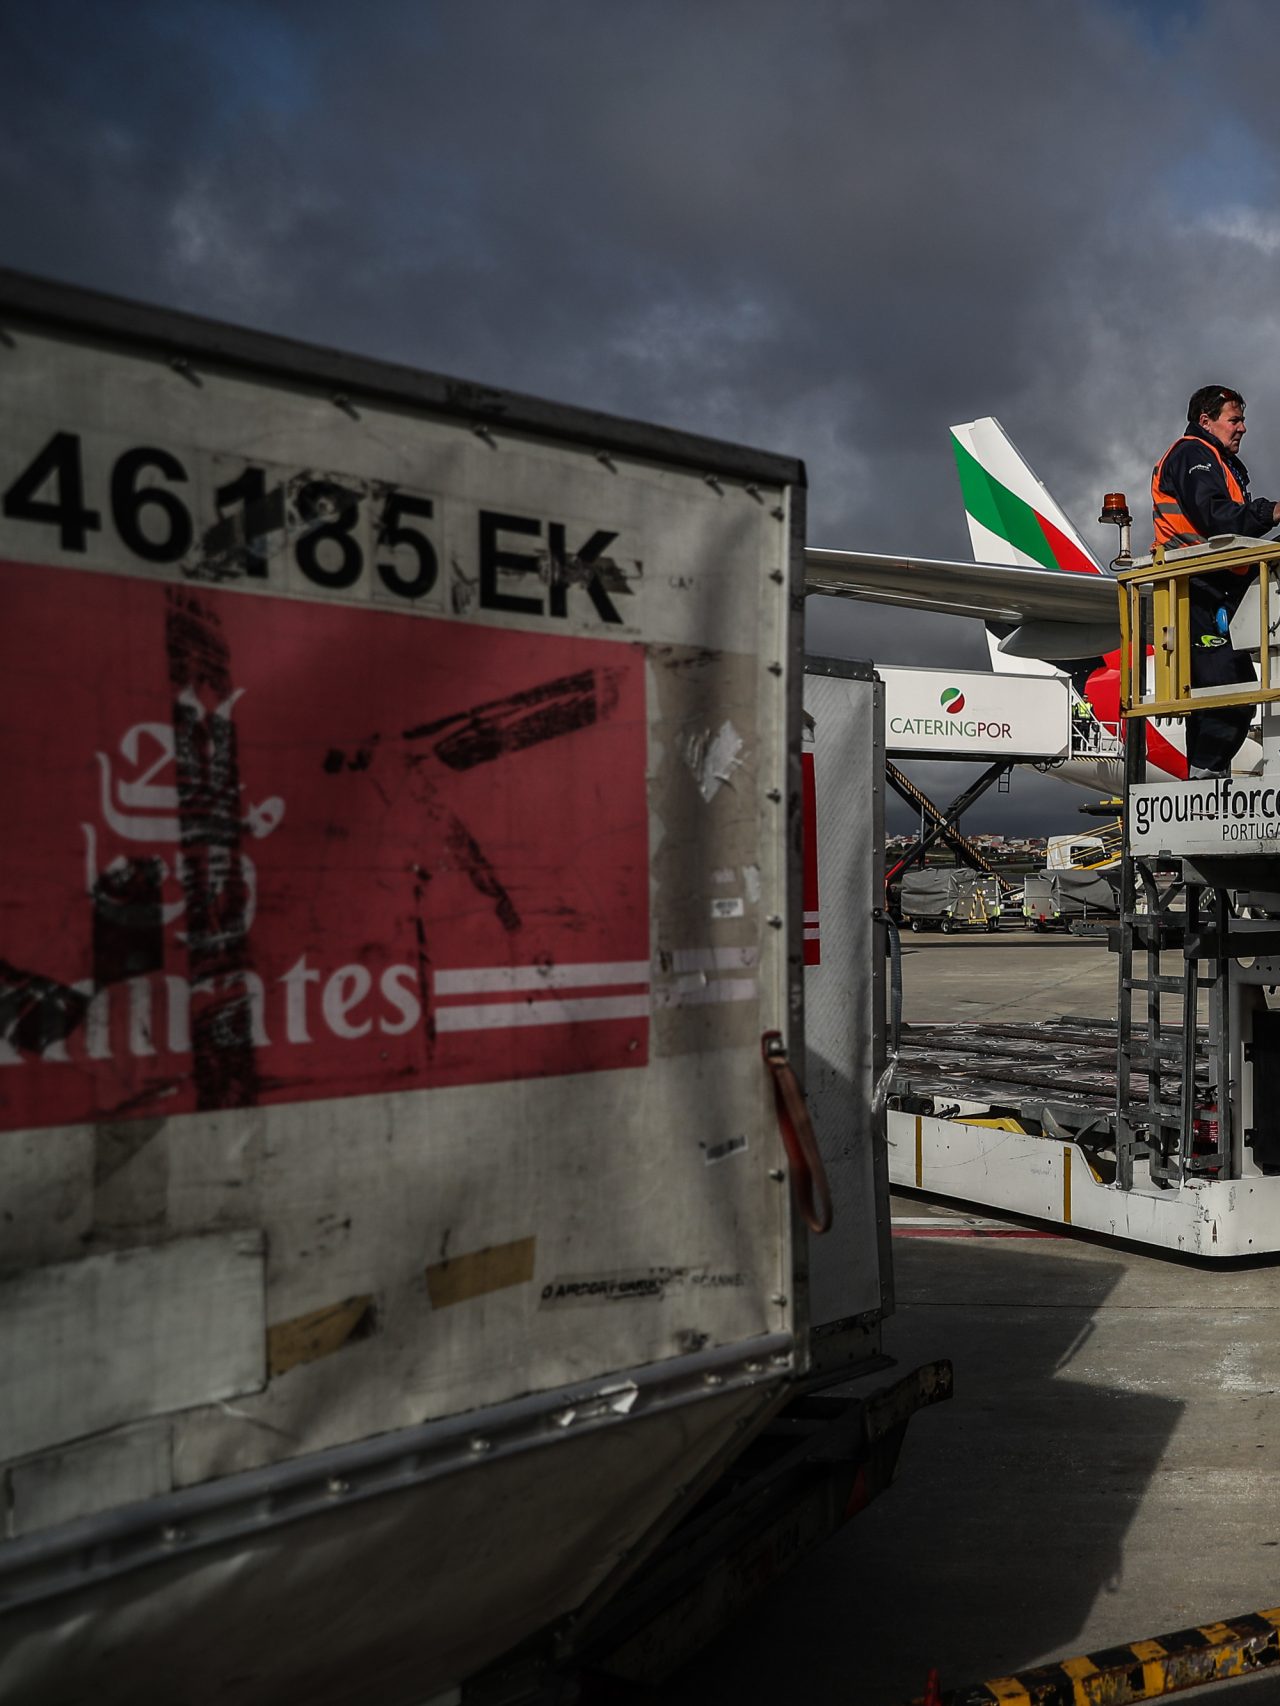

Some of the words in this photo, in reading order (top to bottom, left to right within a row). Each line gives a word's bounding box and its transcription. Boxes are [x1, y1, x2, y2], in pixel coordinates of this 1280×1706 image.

[3, 431, 438, 600] 46185
[478, 510, 624, 625] EK
[890, 717, 1012, 739] CATERINGPOR
